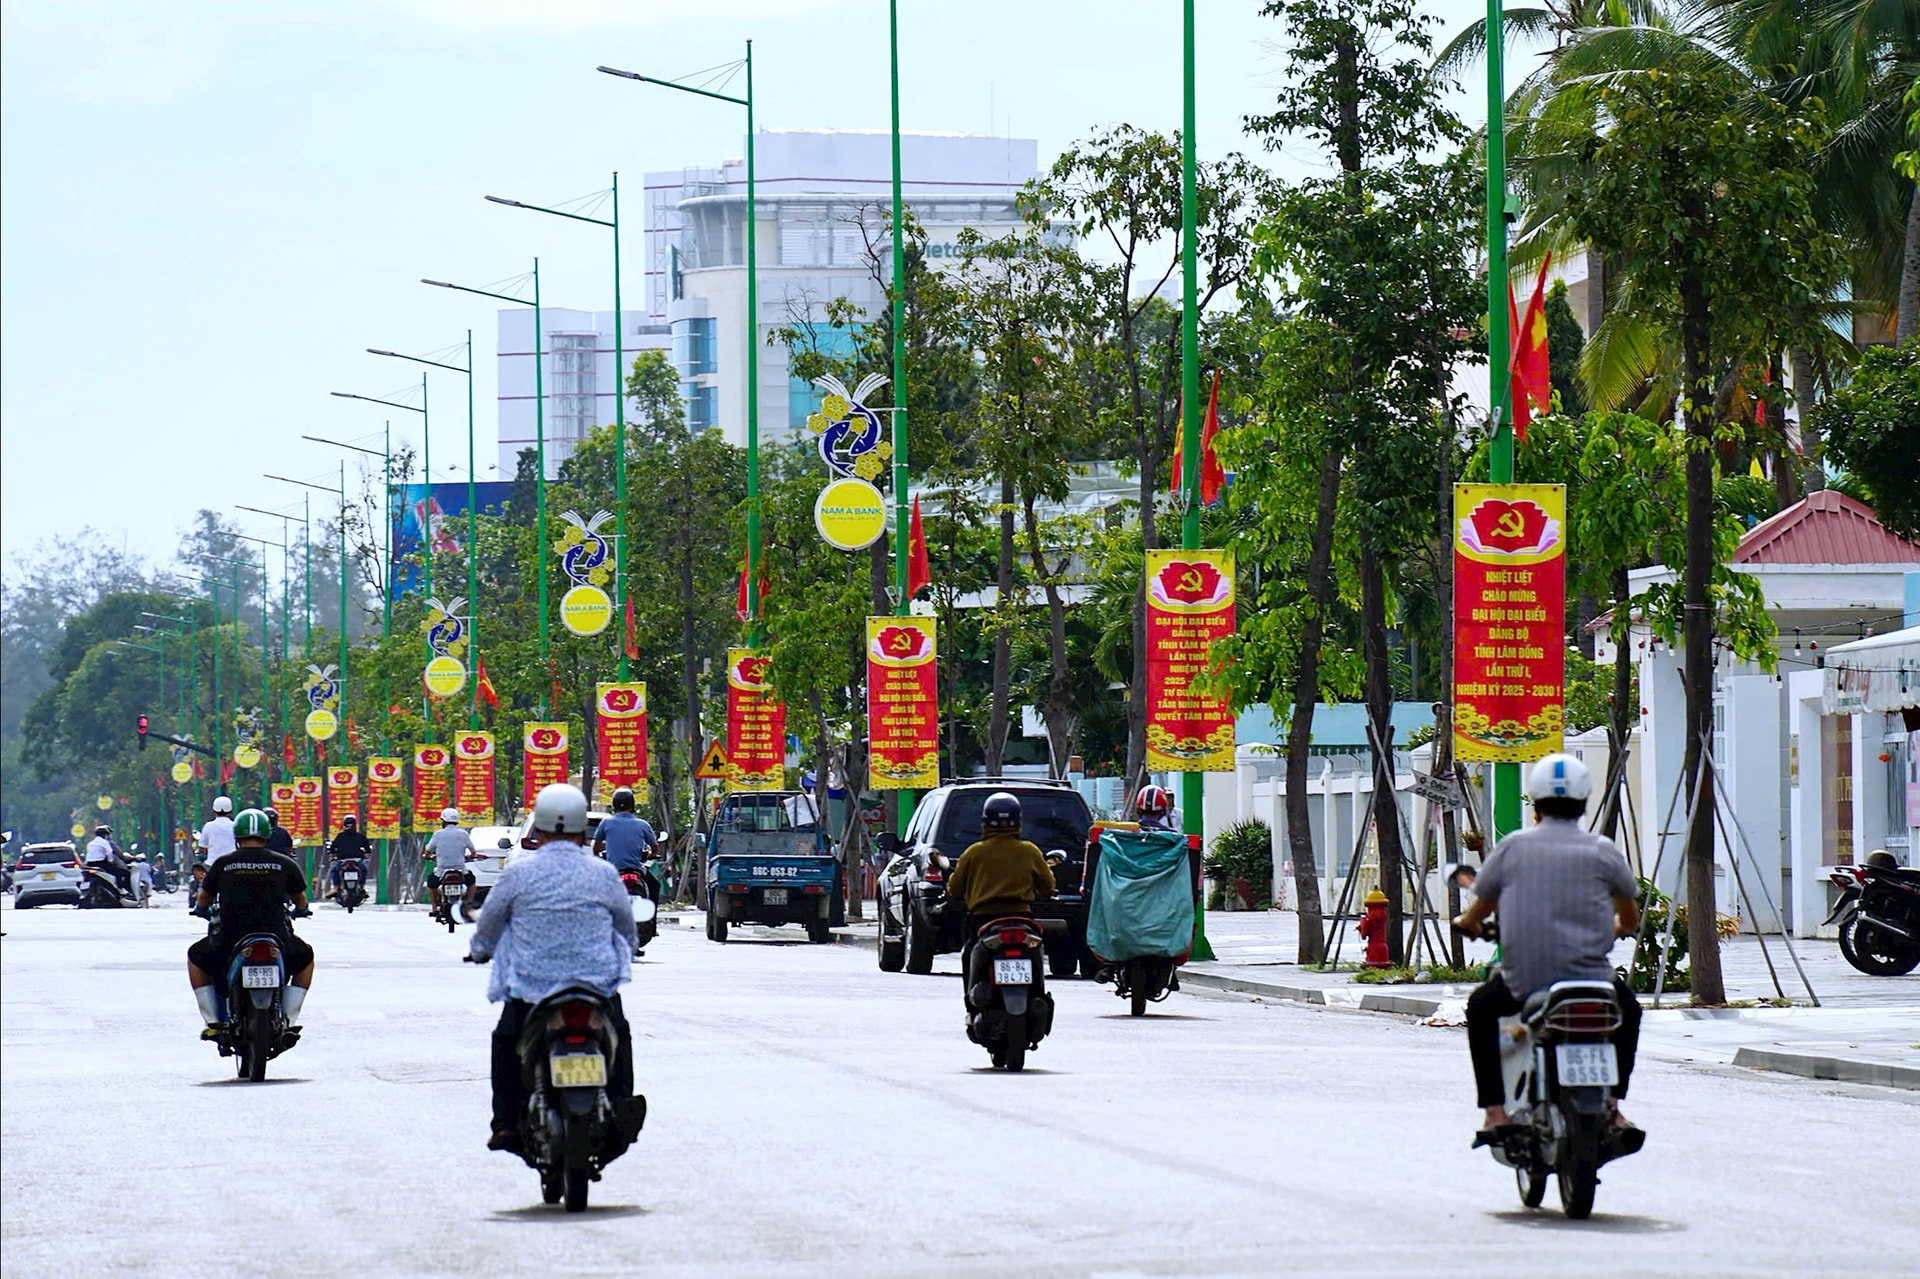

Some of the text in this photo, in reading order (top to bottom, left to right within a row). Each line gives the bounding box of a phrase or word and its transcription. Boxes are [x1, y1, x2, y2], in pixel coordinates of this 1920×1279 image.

[1486, 570, 1533, 585] NHIỆT LIỆT
[1482, 588, 1536, 602] CHÀO MỪNG
[1472, 606, 1546, 623] ĐẠI HỘI ĐẠI BIỂU
[1489, 624, 1529, 642] ĐẢNG BỘ
[1474, 643, 1544, 659] TỈNH LÂM ĐỒNG
[1457, 682, 1486, 698] NHIỆM
[1488, 682, 1500, 696] KỲ
[1502, 685, 1524, 696] 2025
[1532, 685, 1554, 696] 2030
[1155, 712, 1182, 720] QUYẾT
